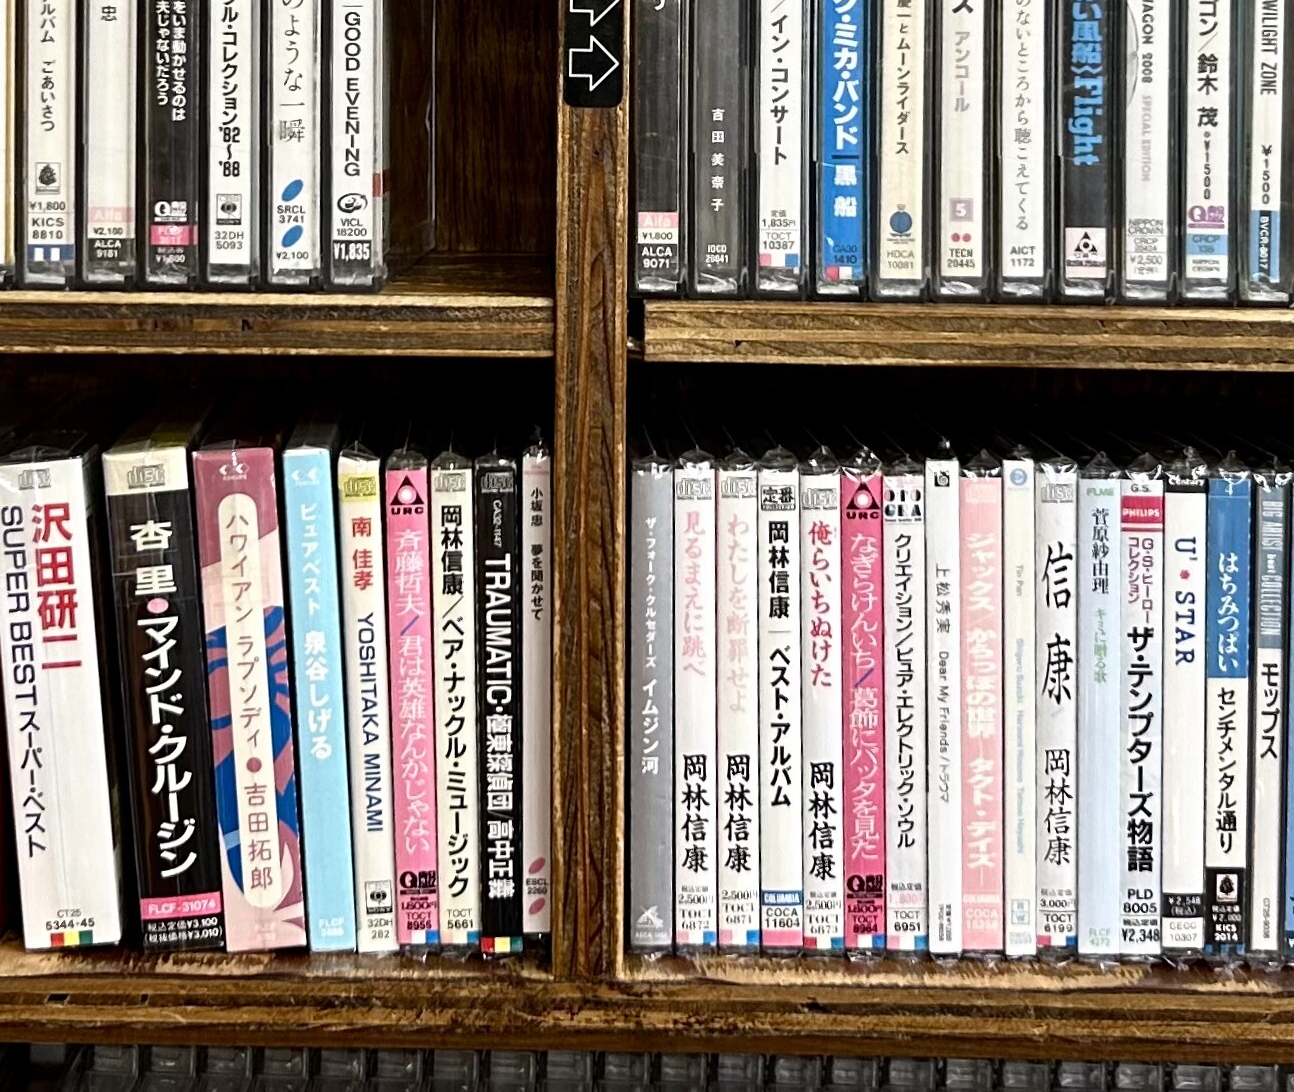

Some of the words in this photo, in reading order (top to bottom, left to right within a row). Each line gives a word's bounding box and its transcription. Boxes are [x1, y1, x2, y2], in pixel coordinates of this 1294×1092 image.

[40, 60, 54, 133] ごあいさつ
[344, 11, 360, 73] GOOD
[954, 30, 970, 113] アンコール
[1260, 62, 1278, 95] ZONE
[344, 77, 360, 178] EVENING
[32, 218, 64, 227] KICS
[333, 241, 370, 261] ¥1,835
[31, 502, 82, 670] 沢田研二
[129, 520, 178, 597] 杏里
[225, 514, 252, 624] ハワイアン
[531, 543, 543, 621] 夢を聞かせて
[808, 520, 835, 688] 俺らいちぬけた
[849, 533, 877, 671] なぎらけんいち
[1218, 553, 1239, 672] はちみつぱい
[1041, 541, 1075, 702] 信康
[236, 635, 262, 748] ラプソディ
[304, 630, 333, 761] 泉谷しげる
[357, 612, 379, 743] YOSHITAKA
[642, 678, 658, 776] イムジン河
[19, 712, 47, 858] スーパー・ベスト
[137, 618, 197, 880] マインド・クルージン
[364, 753, 383, 832] MINAMI
[1125, 626, 1155, 872] ザ・テンプターズ物語
[1216, 687, 1237, 855] センチメンタル通り
[244, 782, 273, 891] 吉田拓郎
[808, 761, 837, 879] 岡林信康
[1121, 927, 1160, 943] ¥2,348
